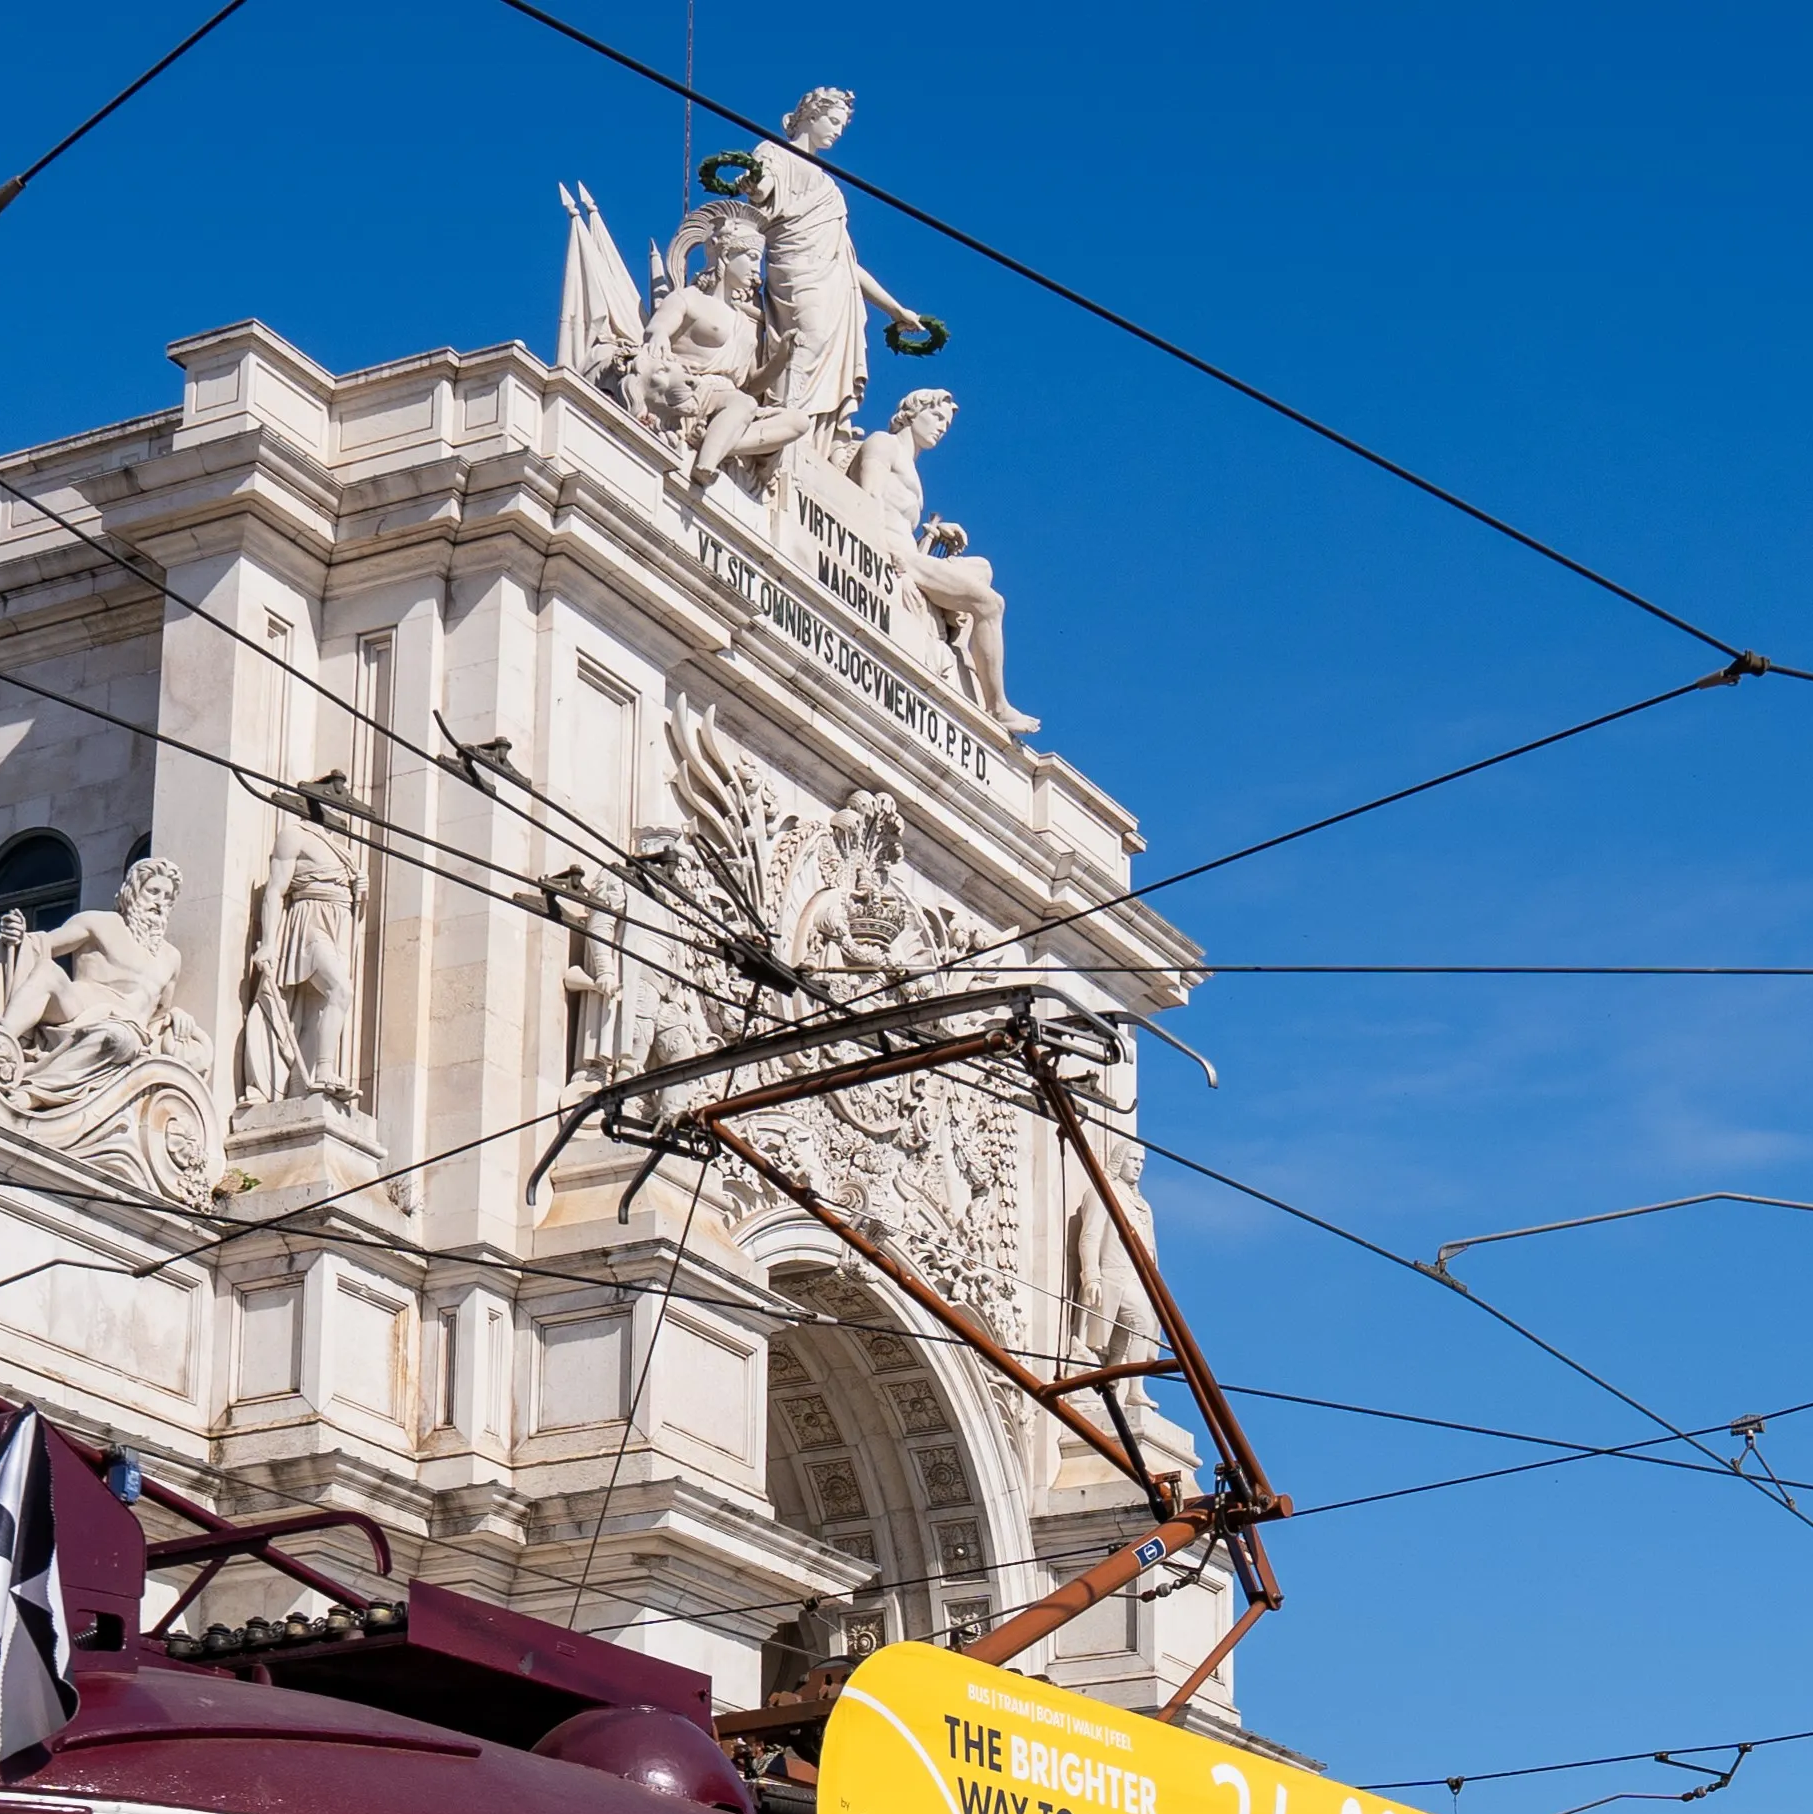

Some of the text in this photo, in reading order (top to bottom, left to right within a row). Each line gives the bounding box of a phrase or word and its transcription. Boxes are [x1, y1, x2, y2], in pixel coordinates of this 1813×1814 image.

[798, 491, 895, 596] VIRTVTIBVS
[818, 551, 891, 635] MAIORVM
[944, 1714, 1002, 1773] THE
[968, 1683, 1134, 1752] BUS TRAM BOAT WALK FEEL
[840, 1797, 850, 1811] by
